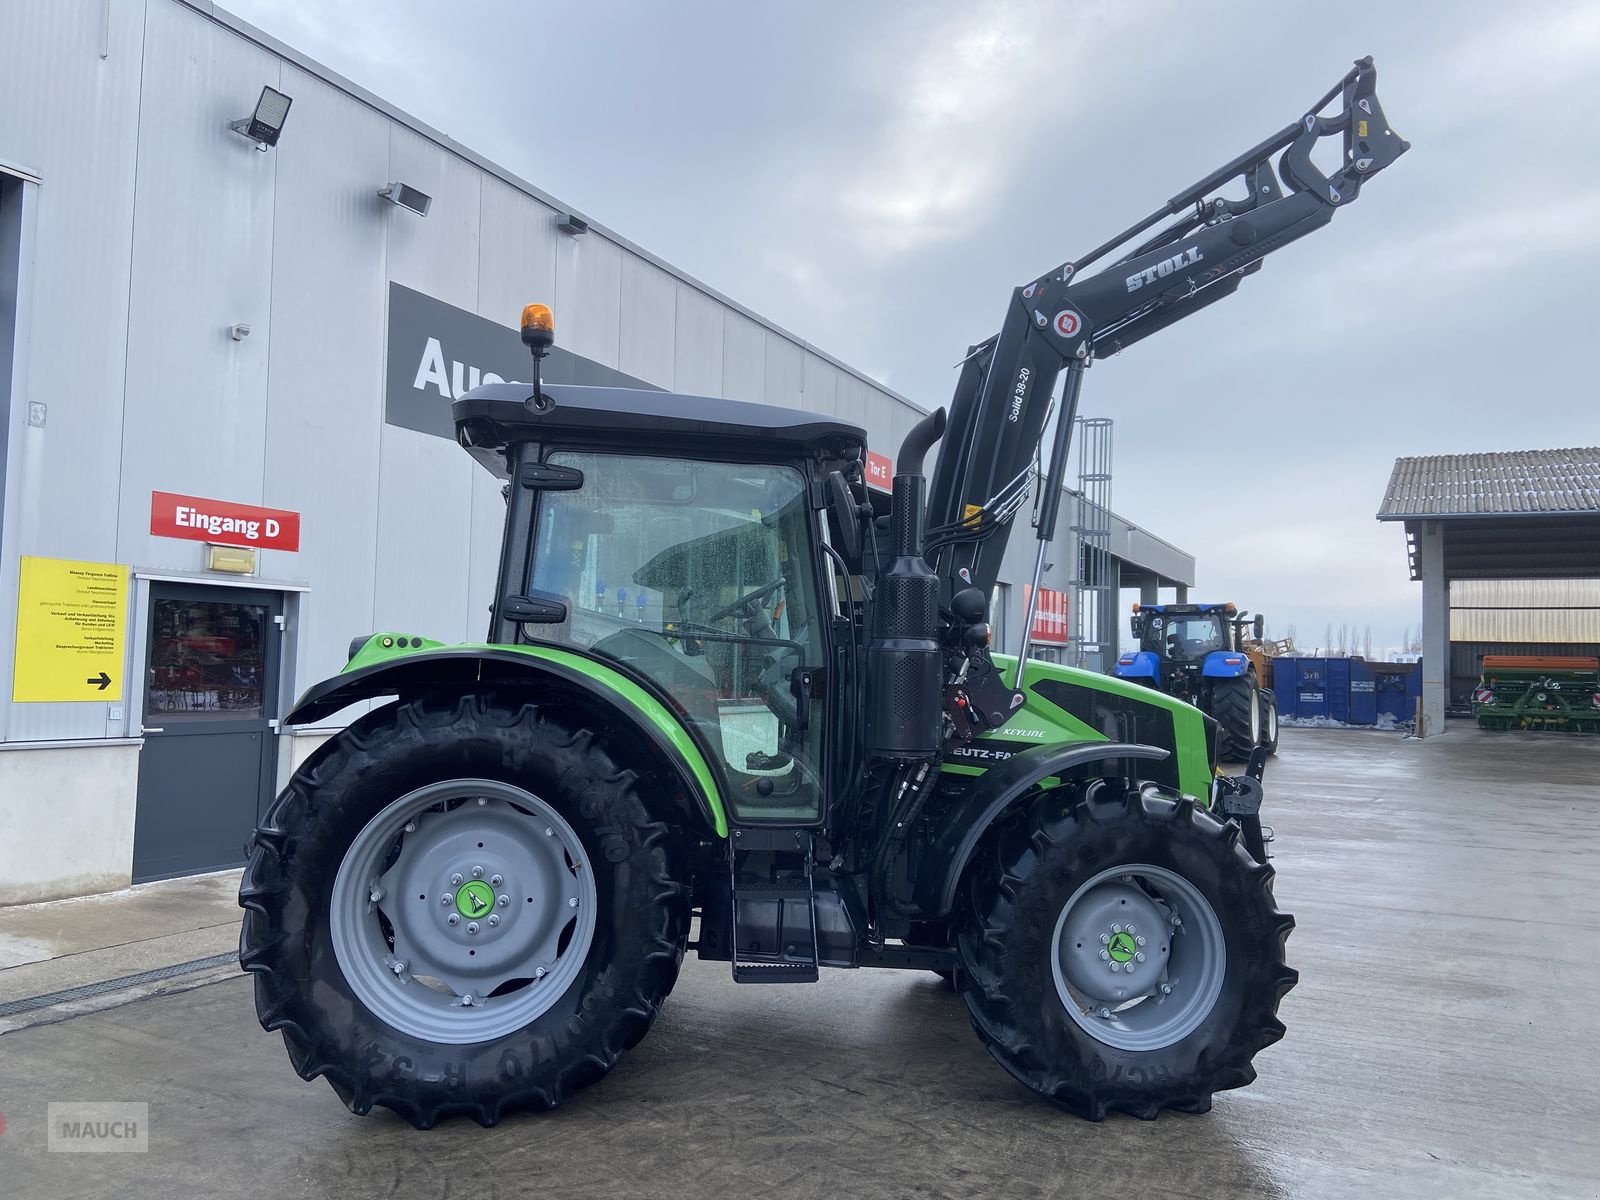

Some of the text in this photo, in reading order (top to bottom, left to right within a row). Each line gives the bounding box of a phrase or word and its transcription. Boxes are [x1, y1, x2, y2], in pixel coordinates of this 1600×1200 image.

[1126, 246, 1204, 293] STOLL
[1008, 367, 1030, 423] Solid 38-20
[869, 460, 887, 479] Tor E
[175, 506, 280, 539] Eingang D
[1003, 728, 1047, 738] KEYLINE
[951, 747, 1017, 760] EUTZ-FA
